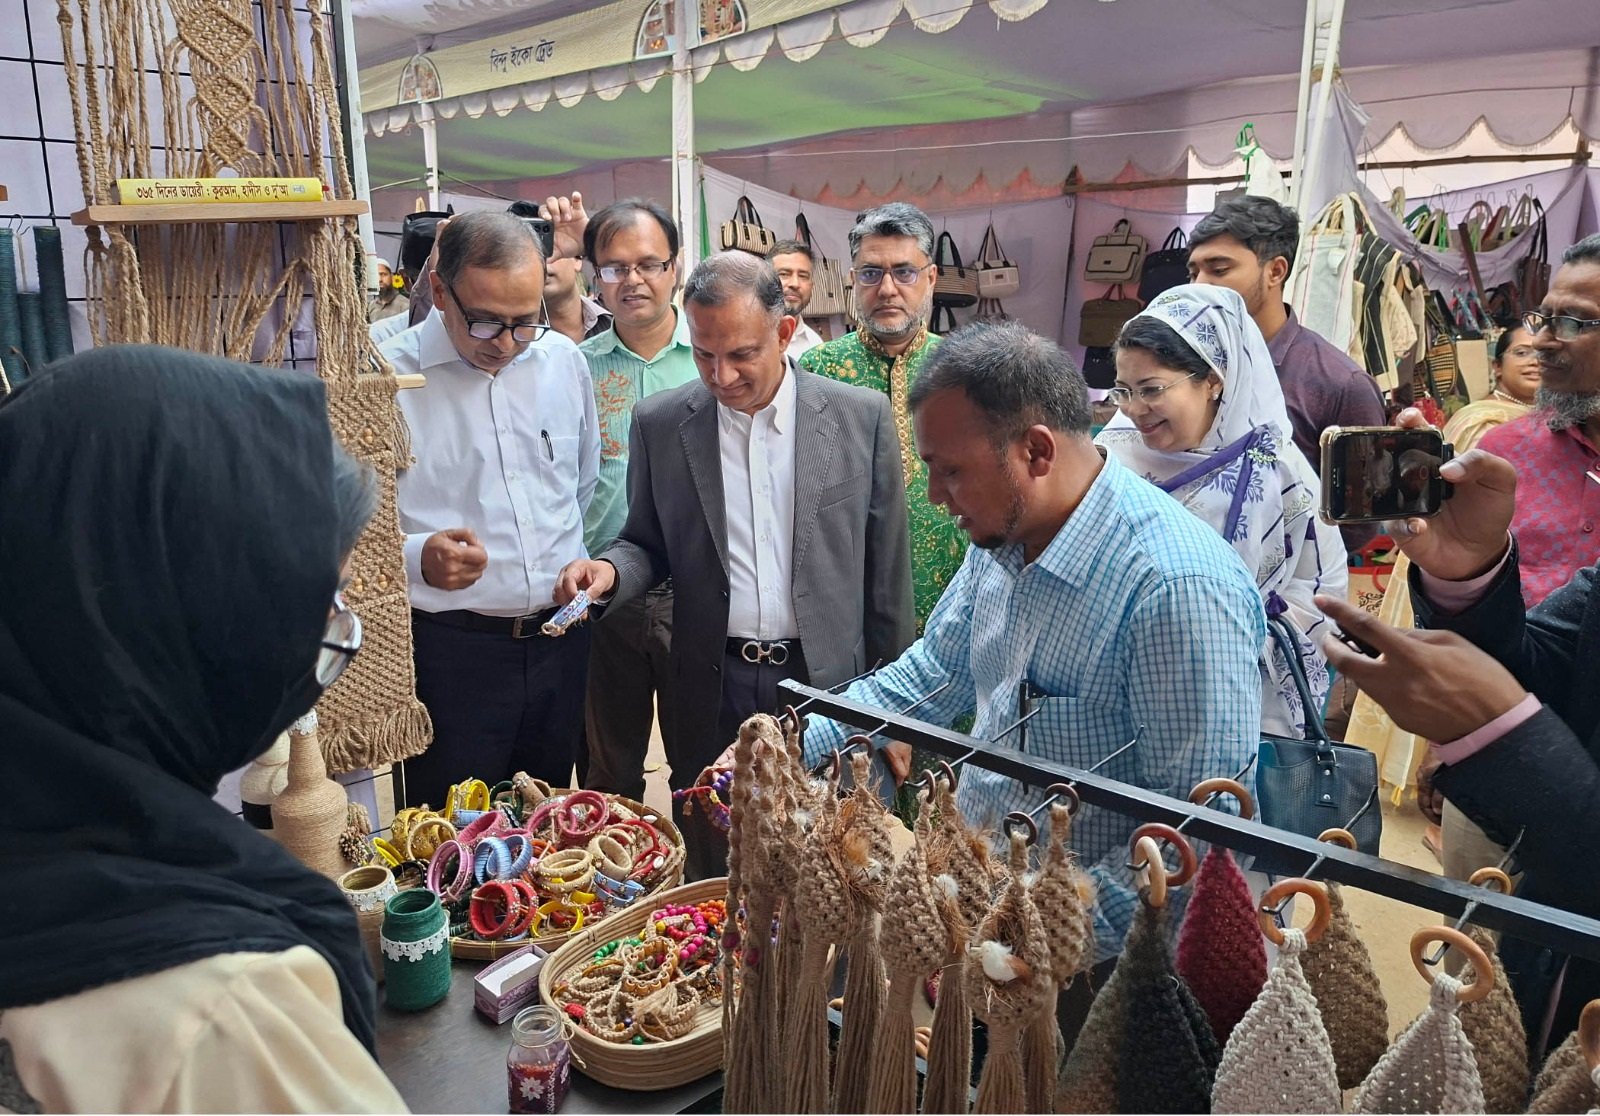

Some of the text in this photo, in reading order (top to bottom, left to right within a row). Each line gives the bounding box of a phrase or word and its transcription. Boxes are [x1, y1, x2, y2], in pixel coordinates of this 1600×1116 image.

[490, 39, 555, 73] বিন্দু ইকো ট্রেড
[136, 186, 153, 198] ৩৬৫
[155, 181, 178, 199] দিনের
[241, 180, 261, 198] হাদীস
[264, 185, 271, 196] ও
